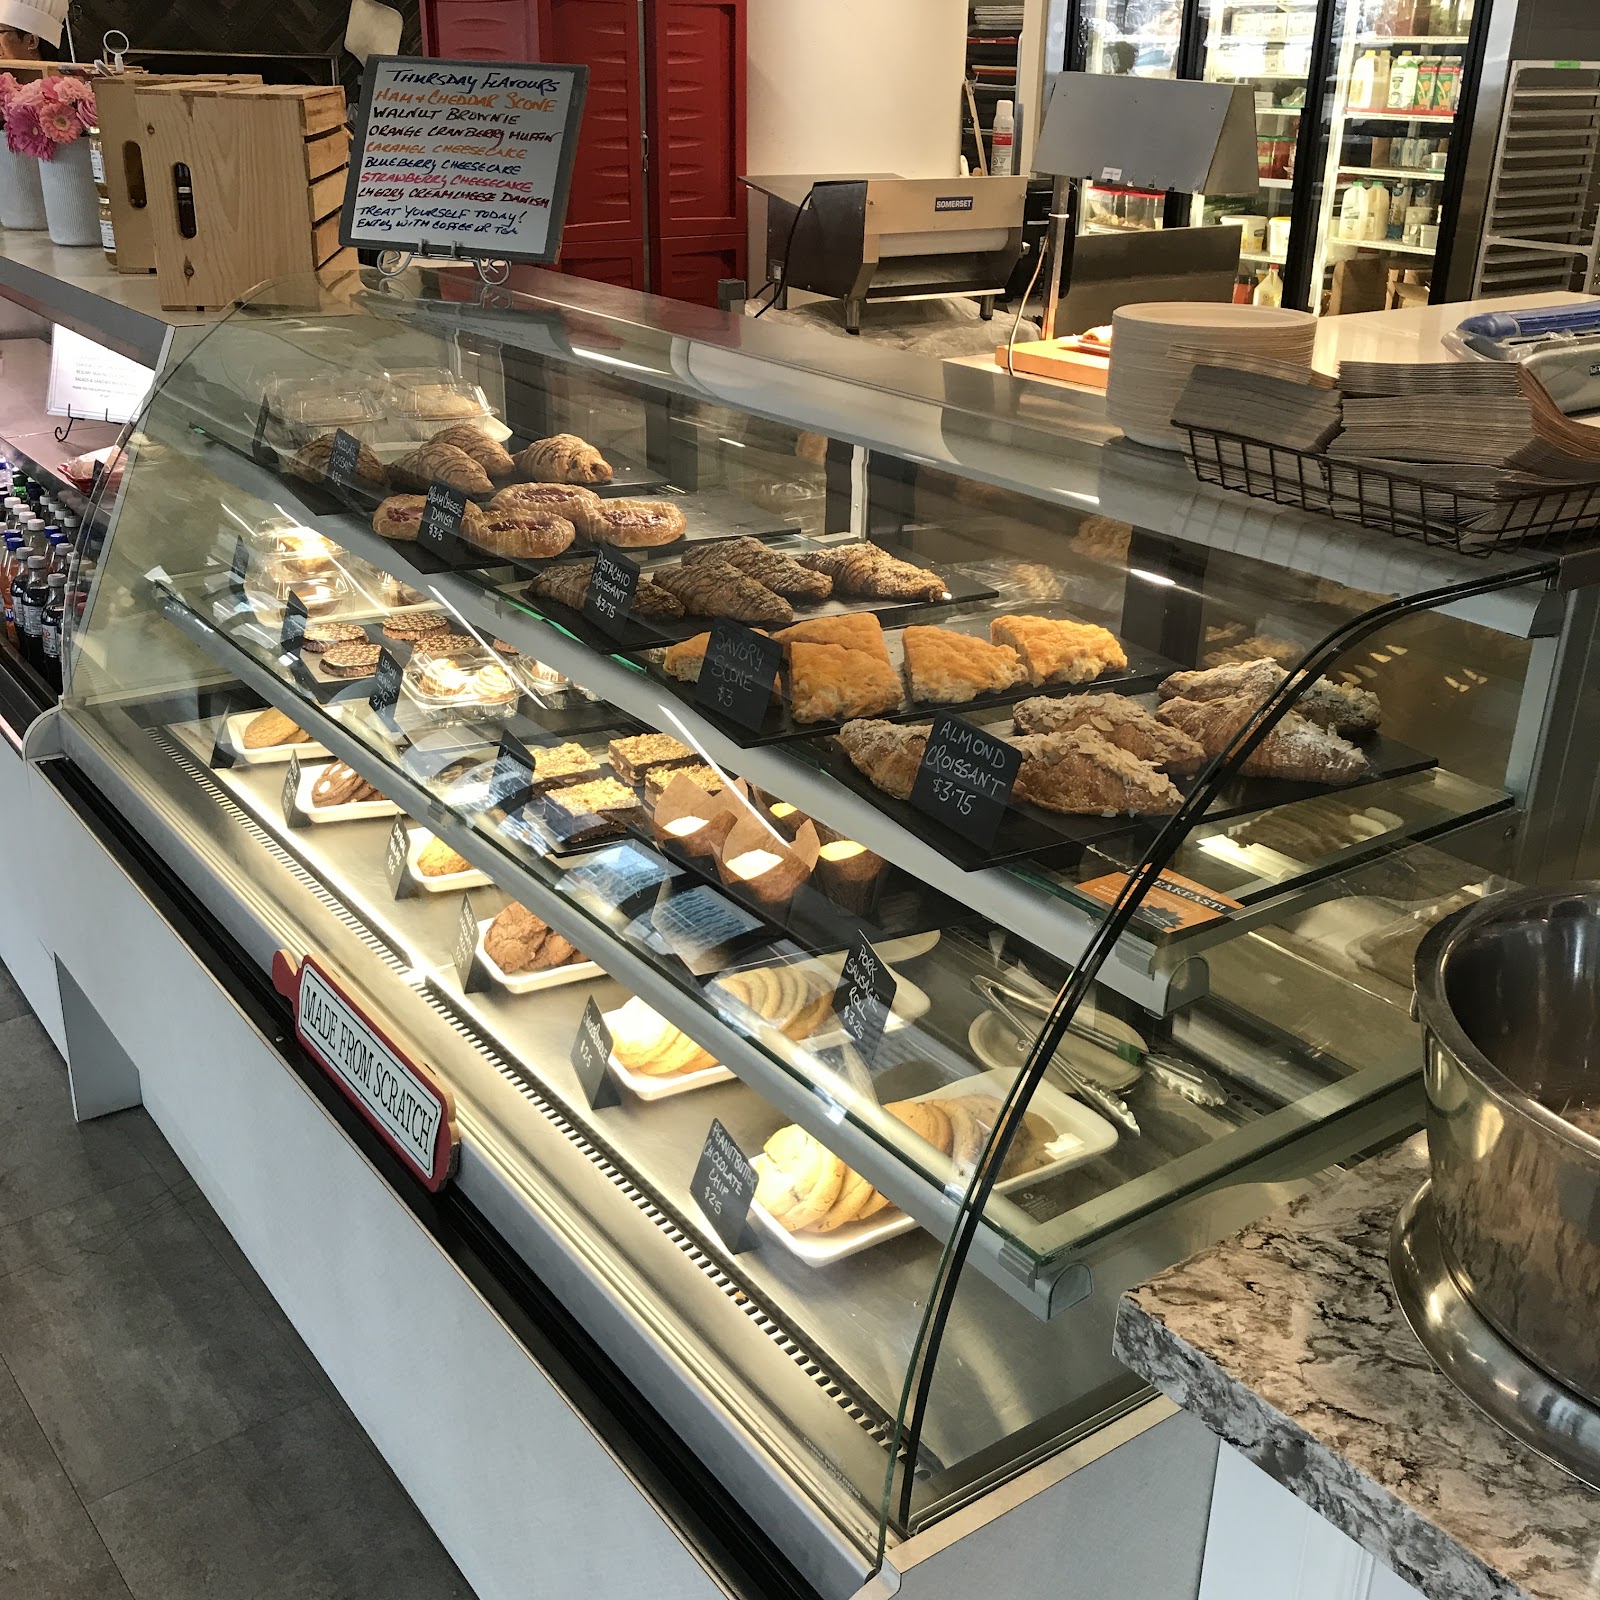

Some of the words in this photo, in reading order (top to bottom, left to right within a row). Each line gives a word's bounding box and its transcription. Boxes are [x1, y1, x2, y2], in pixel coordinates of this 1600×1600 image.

[386, 69, 478, 94] THURSDAY
[480, 72, 560, 96] FLAVOURS
[375, 88, 411, 104] HAM
[427, 92, 500, 109] CHEDDAR
[504, 92, 557, 112] SCONE
[373, 106, 442, 120] WALNUT
[446, 109, 520, 125] BROWNIE
[369, 125, 422, 138] ORANGE
[427, 126, 505, 148] CRANBERRY
[509, 130, 562, 143] MUFFIN
[364, 142, 426, 154] CARAMEL
[432, 145, 529, 159] CHEESECAKE
[364, 156, 436, 175] BLUEBERRY
[441, 159, 522, 175] CHEESECAKE
[361, 172, 447, 190] STRAWBERRY
[450, 175, 534, 193] CHEESECAKE
[358, 187, 404, 202] CHERRY
[500, 192, 550, 208] DANISH
[936, 199, 972, 208] SOMERSET
[357, 206, 402, 217] TREAT
[405, 206, 470, 220] YOURSELF
[475, 208, 528, 227] TODAY!
[396, 218, 430, 228] WITH
[432, 221, 473, 232] COFFEE
[474, 223, 492, 233] OR
[431, 506, 455, 529] DANISH
[597, 549, 631, 587] PISTACHIO
[592, 571, 628, 603] CROISSANT
[716, 626, 765, 672] SAVORY
[711, 655, 754, 693] SCONE
[939, 720, 1006, 769] ALMOND
[925, 744, 1007, 796] CROISSANT
[858, 944, 878, 983] PORK
[846, 958, 880, 1013] SAUSAGE
[304, 984, 338, 1049] MADE
[340, 1021, 374, 1089] FROM
[373, 1062, 434, 1155] SCRATCH
[703, 1138, 743, 1196] CHOCOLATE
[708, 1168, 730, 1196] CHIP
